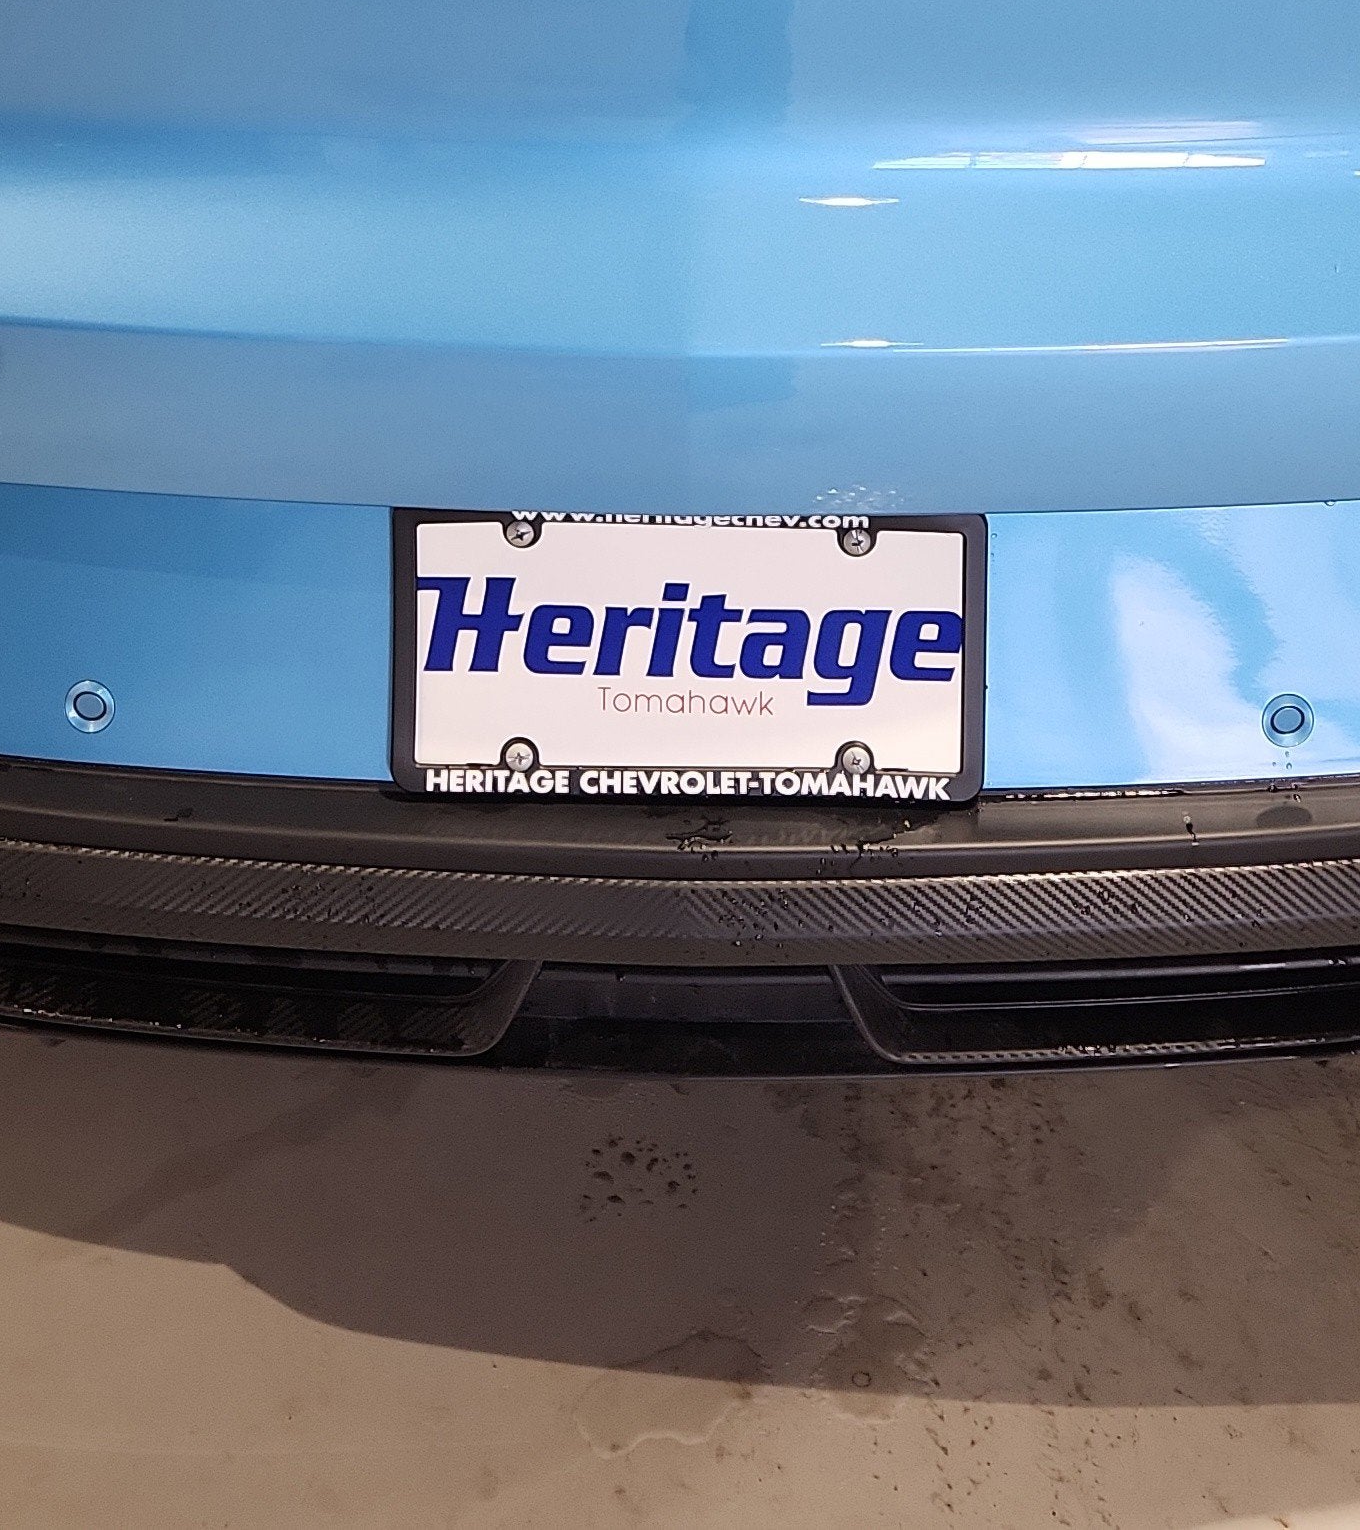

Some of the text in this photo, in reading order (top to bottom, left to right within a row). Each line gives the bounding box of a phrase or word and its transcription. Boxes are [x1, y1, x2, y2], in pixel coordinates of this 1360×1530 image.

[417, 576, 962, 706] Heritage
[597, 686, 774, 716] Tomahawk
[426, 769, 951, 801] HERITAGE CHEVROLET-TOMAHAWK
